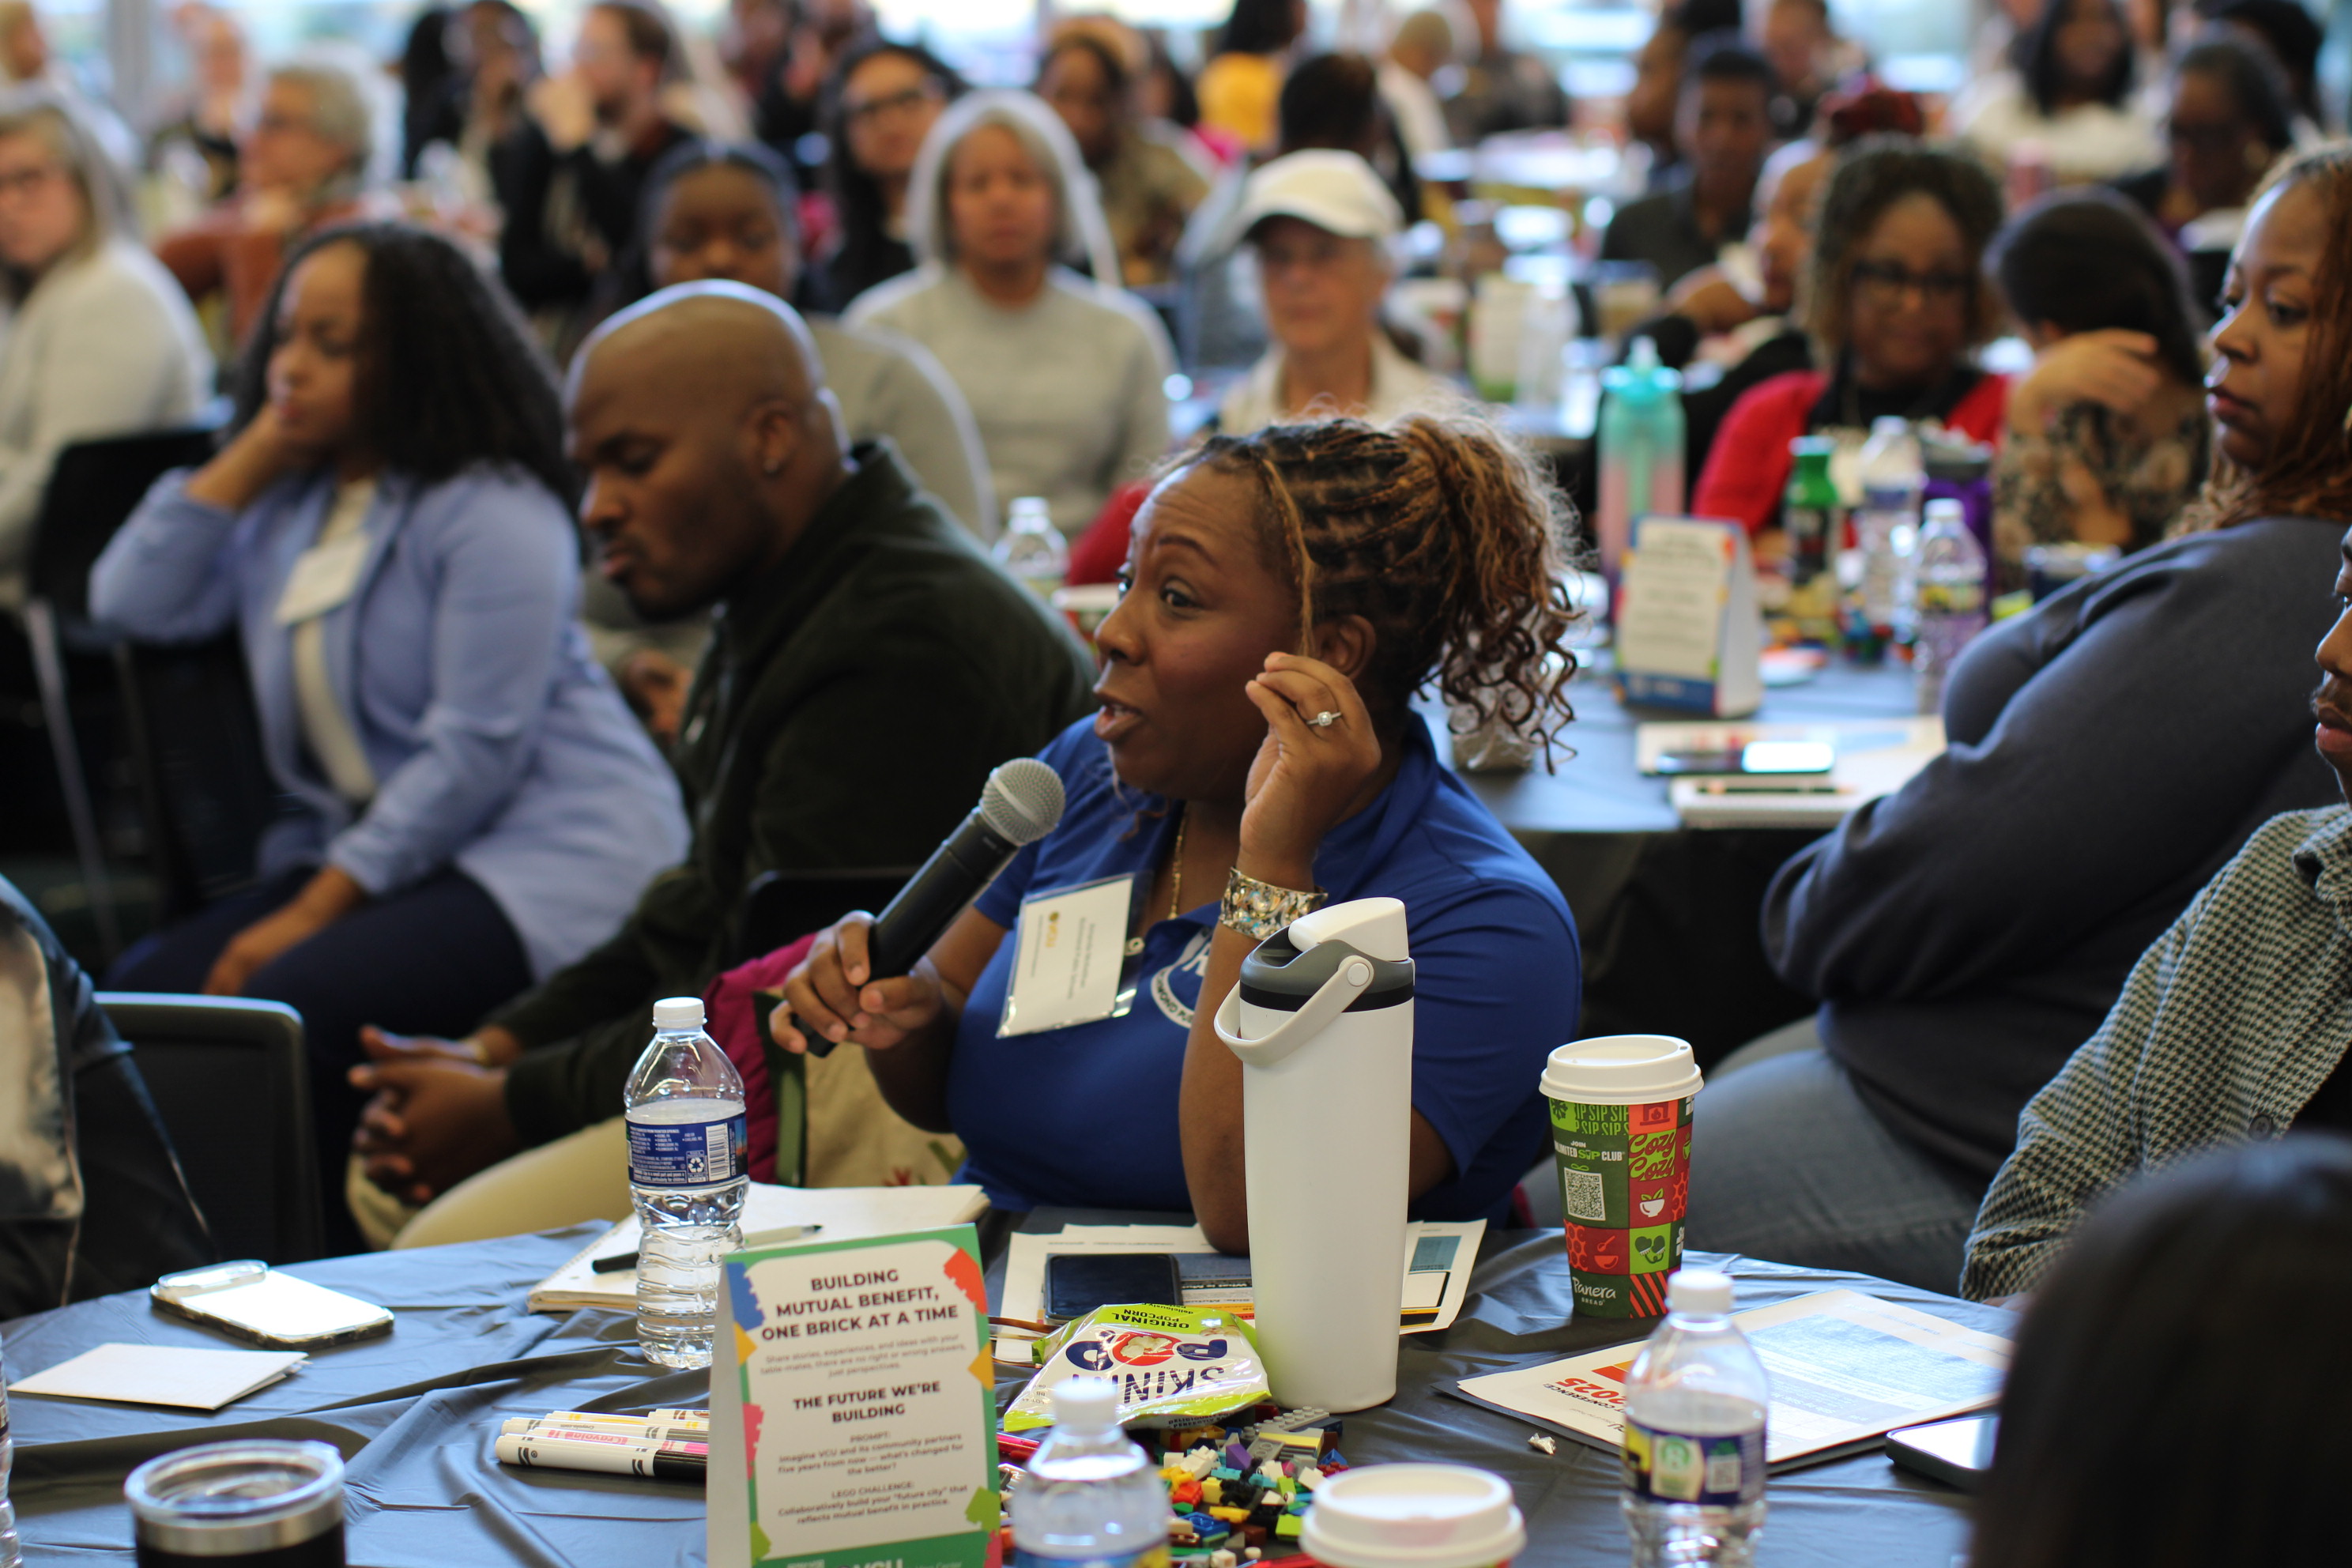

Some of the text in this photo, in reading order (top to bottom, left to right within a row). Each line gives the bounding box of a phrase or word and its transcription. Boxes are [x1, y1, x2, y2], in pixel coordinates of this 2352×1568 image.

[1589, 1104, 1608, 1121] SIP
[1629, 1132, 1676, 1158] Cozy
[1629, 1155, 1675, 1181] Cozy
[811, 1268, 899, 1291] BUILDING
[1571, 1276, 1616, 1298] Panera
[776, 1286, 940, 1317] MUTUAL BENEFIT,
[1581, 1297, 1604, 1306] BREAD
[761, 1305, 959, 1340] ONE BRICK AT A TIME
[1111, 1312, 1189, 1329] ORIGINAL
[1124, 1309, 1180, 1322] POPCORN
[879, 1340, 895, 1350] and
[793, 1381, 941, 1410] THE FUTURE WE'RE
[1555, 1378, 1628, 1404] 2025
[831, 1403, 906, 1423] BUILDING
[572, 1432, 623, 1443] Crayola
[850, 1430, 891, 1443] PROMPT:
[778, 1464, 796, 1476] five
[797, 1462, 822, 1474] years
[823, 1457, 846, 1468] from
[847, 1456, 867, 1465] now
[910, 1444, 949, 1458] changed
[952, 1442, 964, 1452] for
[779, 1452, 816, 1463] Imagine
[819, 1449, 838, 1458] VCU
[839, 1446, 858, 1456] and
[872, 1438, 922, 1452] community
[924, 1433, 962, 1446] partners
[846, 1462, 897, 1476] the better?
[778, 1501, 845, 1517] Collaboratively
[846, 1497, 869, 1508] build
[871, 1494, 891, 1506] your
[949, 1483, 967, 1494] that
[831, 1480, 915, 1499] LEGO CHALLENGE:
[797, 1498, 950, 1525] reflects mutual benefit in practice.
